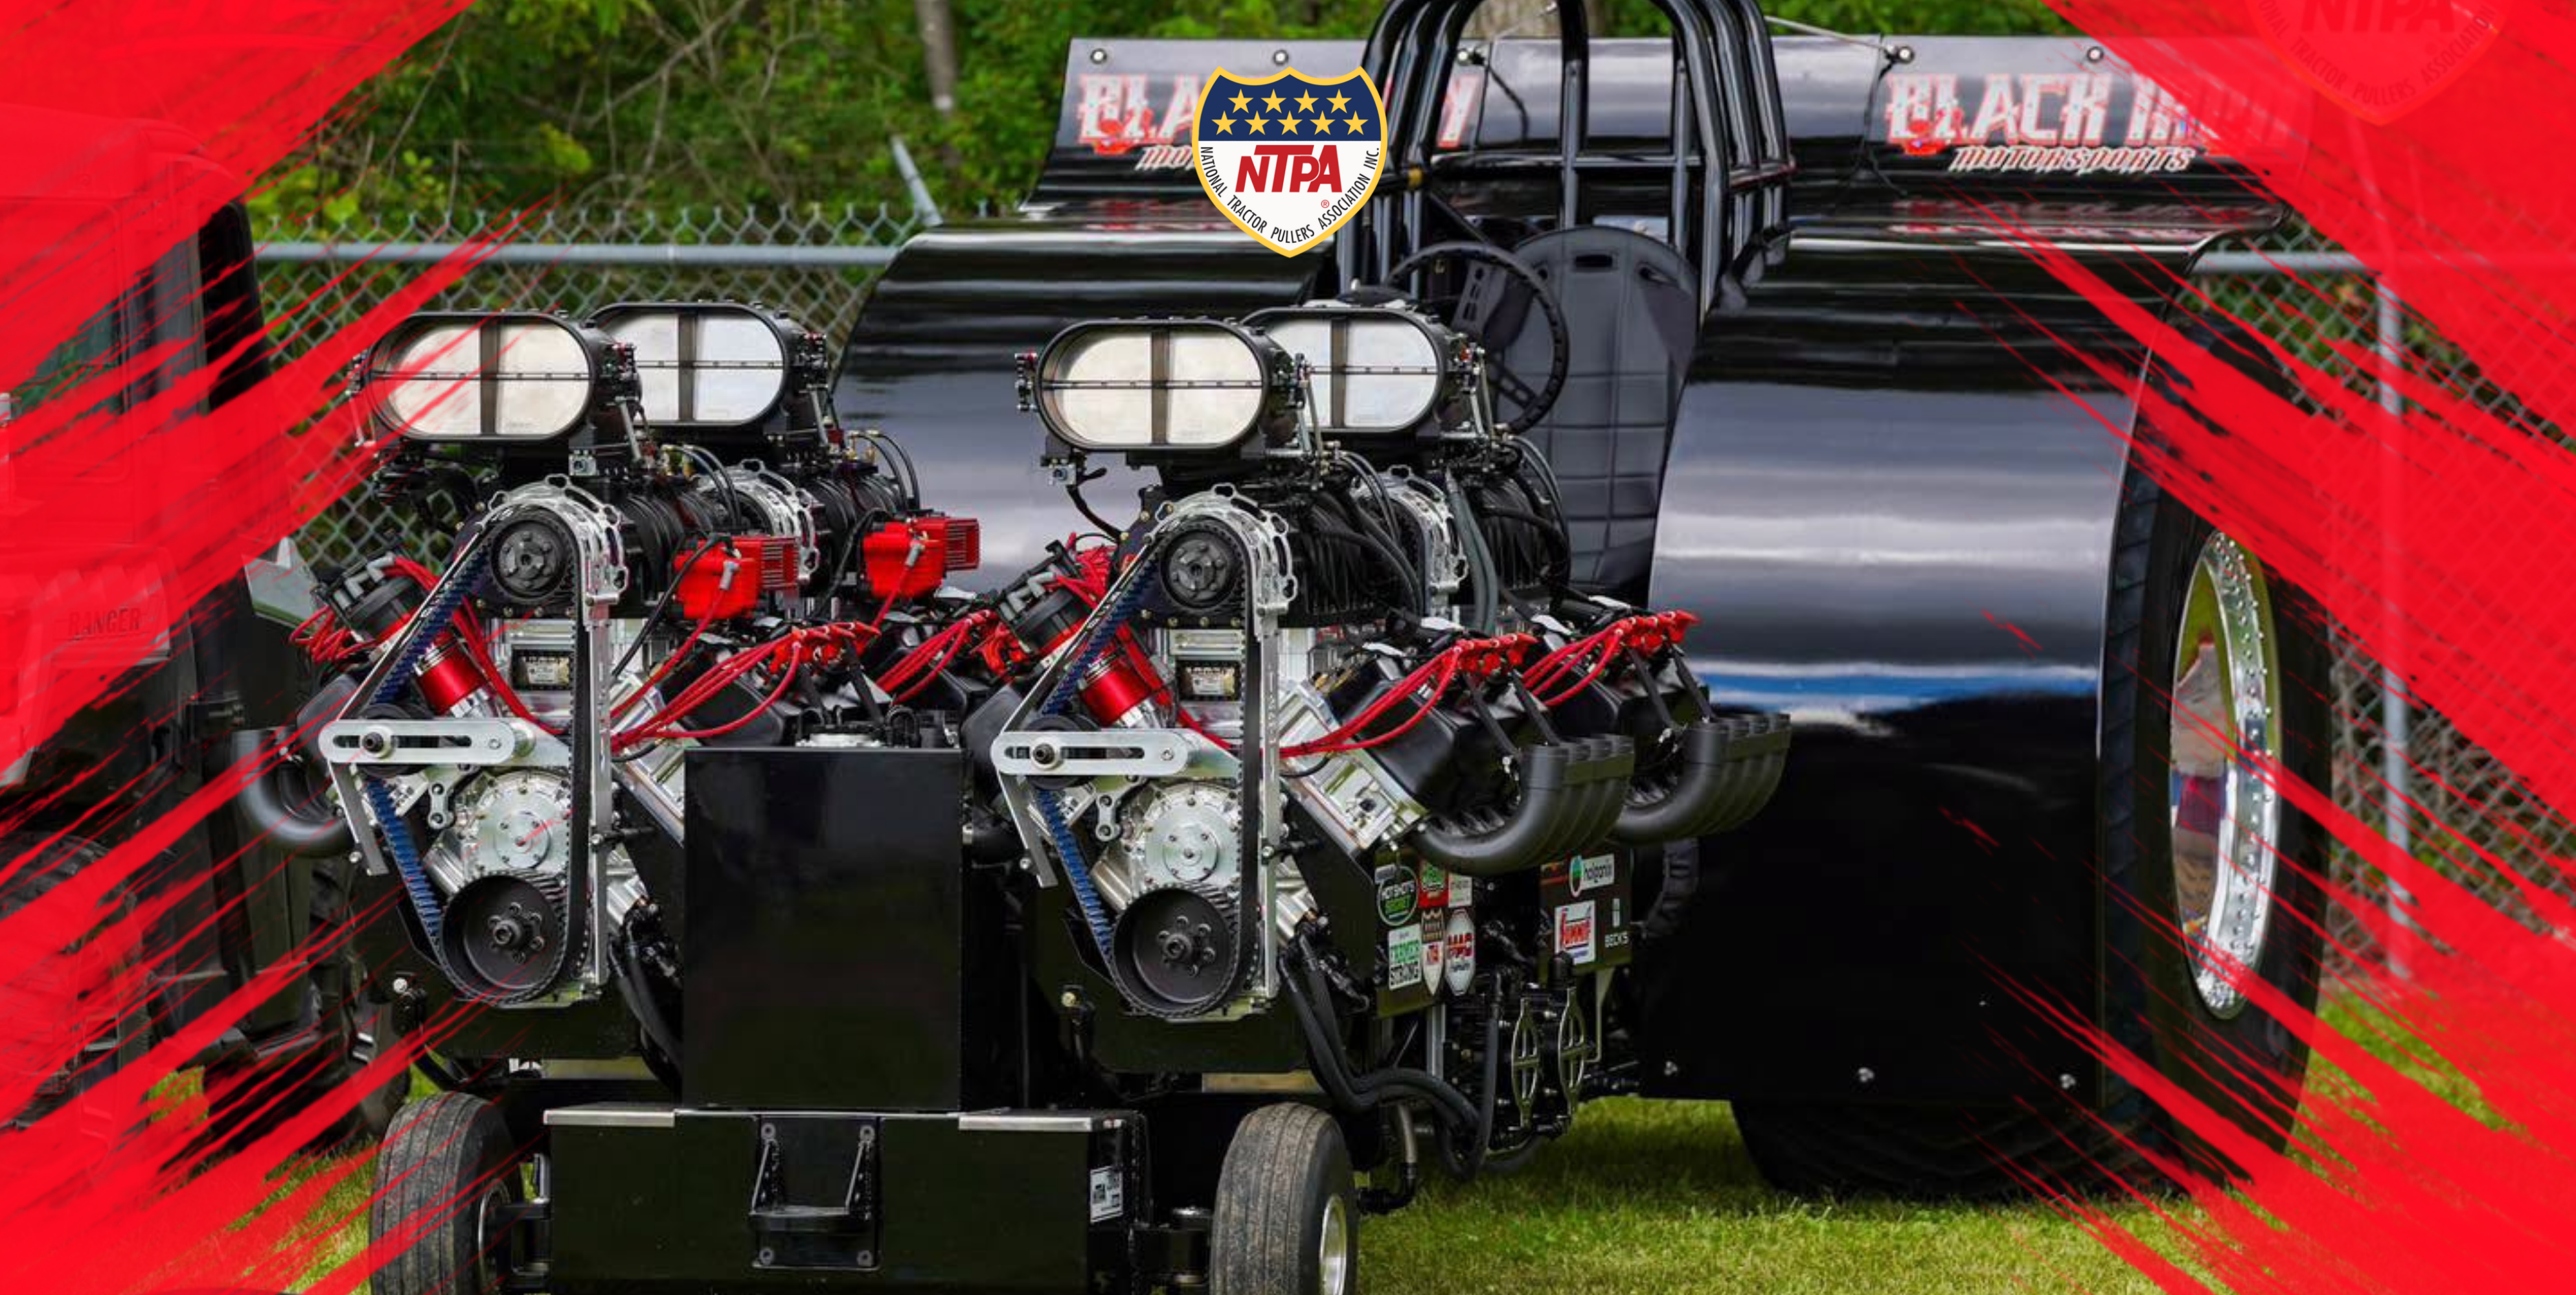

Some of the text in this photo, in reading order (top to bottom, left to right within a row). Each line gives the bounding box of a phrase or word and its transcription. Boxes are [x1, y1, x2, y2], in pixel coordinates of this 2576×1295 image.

[1077, 73, 1201, 146] BLA
[1885, 73, 2114, 148] BLACK
[1948, 144, 2196, 175] MOTORSPORTS
[68, 607, 141, 637] RANGER
